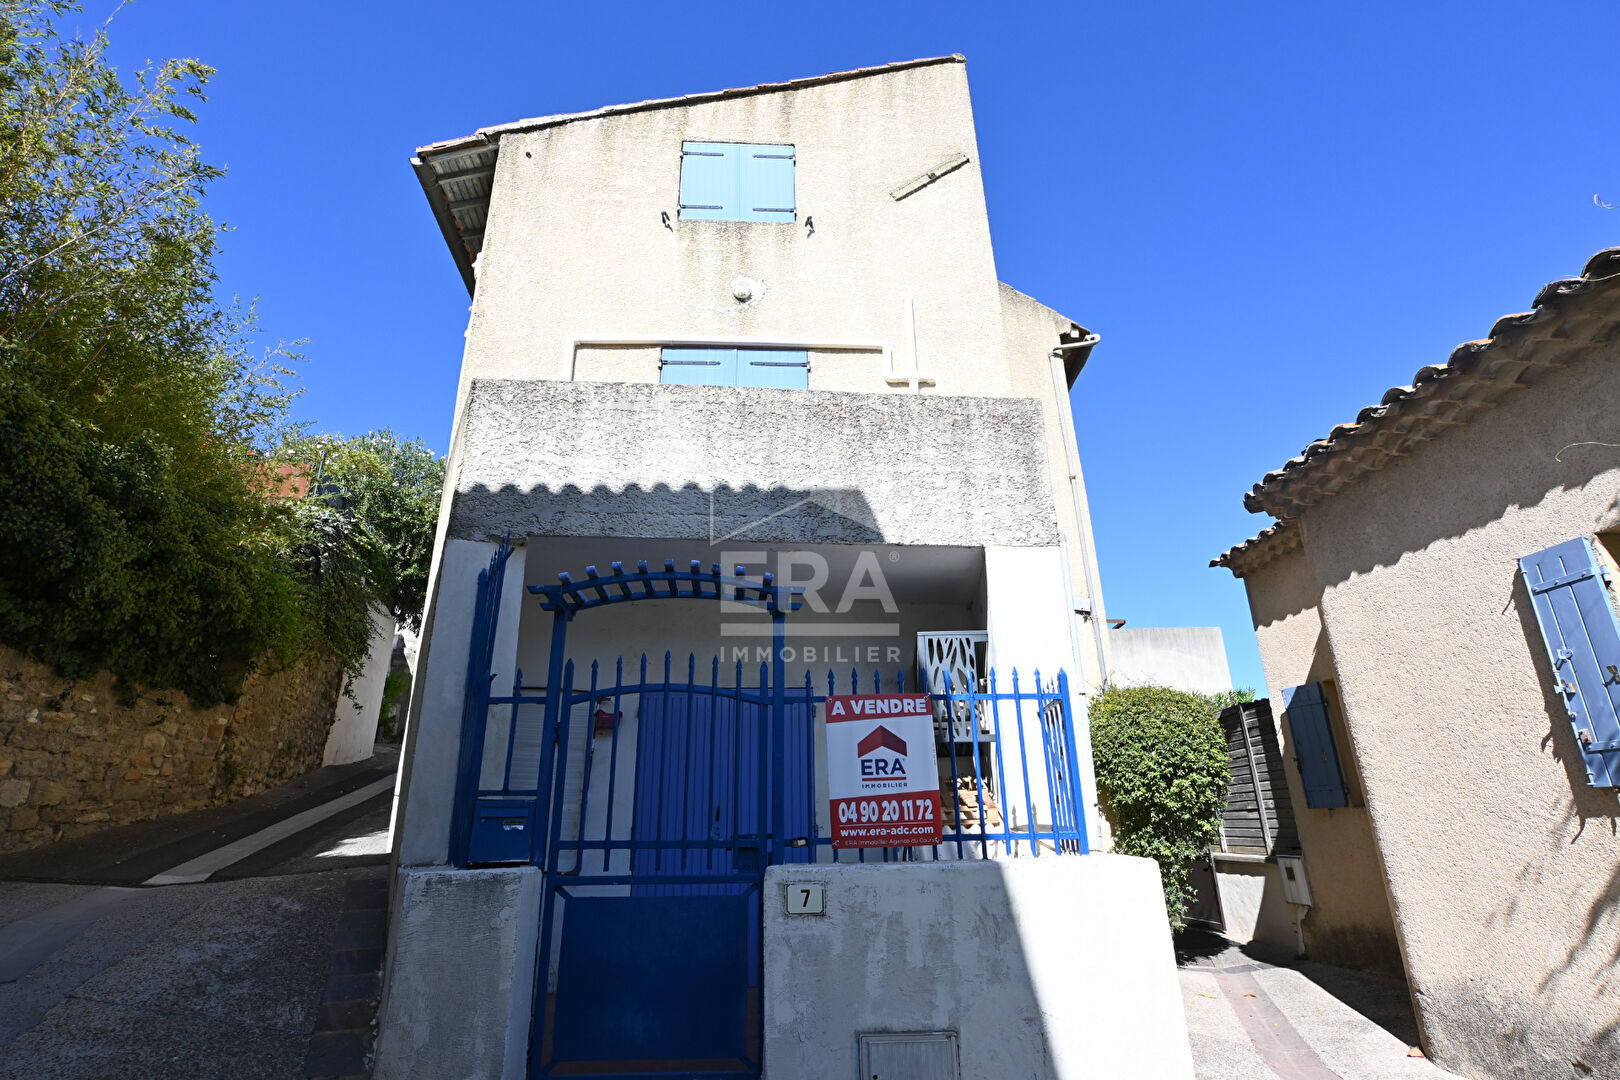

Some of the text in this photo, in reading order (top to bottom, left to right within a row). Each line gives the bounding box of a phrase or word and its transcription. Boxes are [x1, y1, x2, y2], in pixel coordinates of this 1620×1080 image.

[832, 698, 927, 715] A VENDRE
[861, 758, 906, 775] ERA
[838, 799, 934, 823] 04 90 20 11 72
[840, 826, 934, 837] www.era-adc.com
[800, 889, 810, 907] 7
